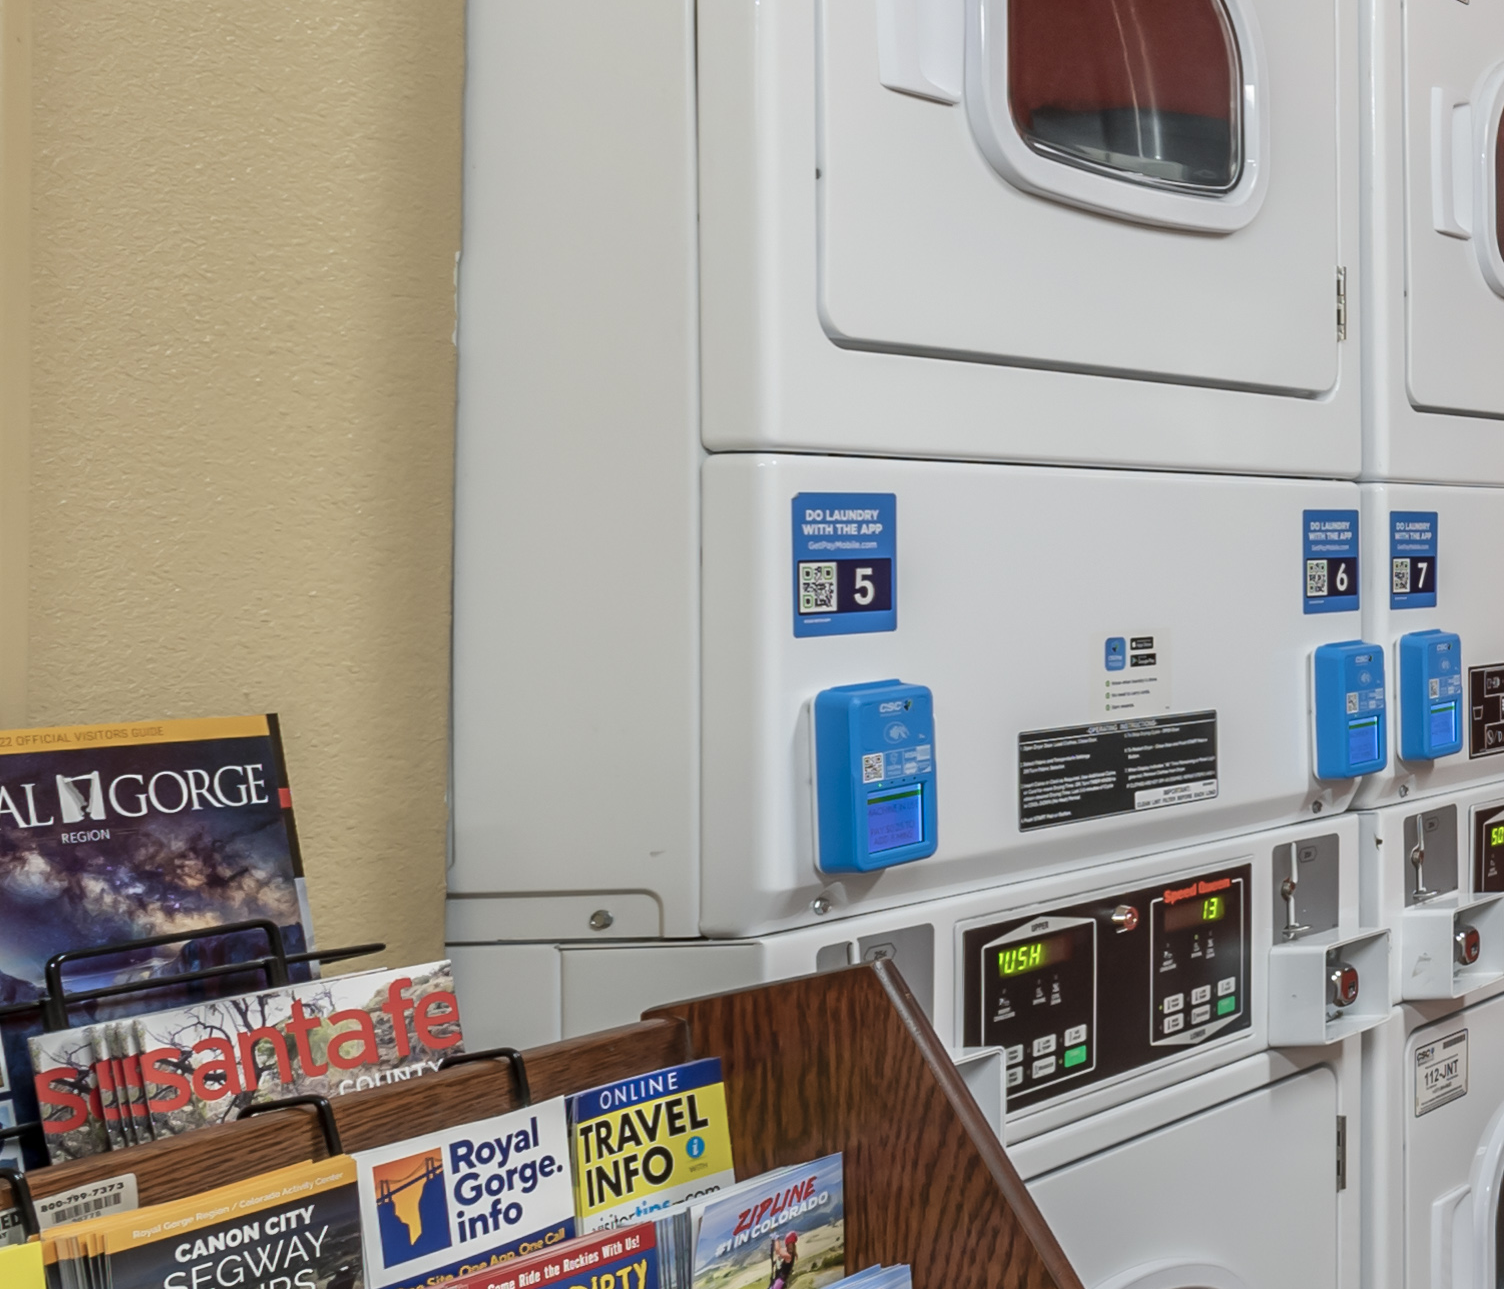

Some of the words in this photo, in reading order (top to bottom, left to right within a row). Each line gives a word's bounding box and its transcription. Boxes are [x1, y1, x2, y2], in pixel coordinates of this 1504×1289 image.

[802, 523, 834, 535] WITH
[835, 524, 858, 535] THE
[860, 523, 883, 535] APP
[805, 509, 824, 521] DO
[826, 509, 879, 521] LAUNDRY
[854, 567, 875, 605] 5
[1336, 563, 1348, 591] 6
[1417, 562, 1428, 588] 7
[108, 764, 269, 818] GORGE
[61, 828, 111, 845] REGION
[1491, 826, 1504, 846] 50
[1163, 884, 1197, 904] Speed
[1203, 897, 1219, 920] 13
[600, 1071, 679, 1109] ONLINE
[1424, 1059, 1459, 1086] 112-JNT
[449, 1116, 540, 1174] Royal
[579, 1093, 709, 1163] TRAVEL
[453, 1152, 563, 1206] Gorge.
[587, 1145, 674, 1208] INFO
[457, 1198, 523, 1244] info
[732, 1176, 817, 1236] ZIPLINE
[175, 1220, 260, 1263] CANON
[264, 1204, 315, 1237] CITY
[518, 1270, 541, 1288] Ride
[543, 1262, 560, 1278] the
[563, 1248, 599, 1271] Rockies
[602, 1241, 623, 1259] With
[625, 1234, 640, 1251] Us!
